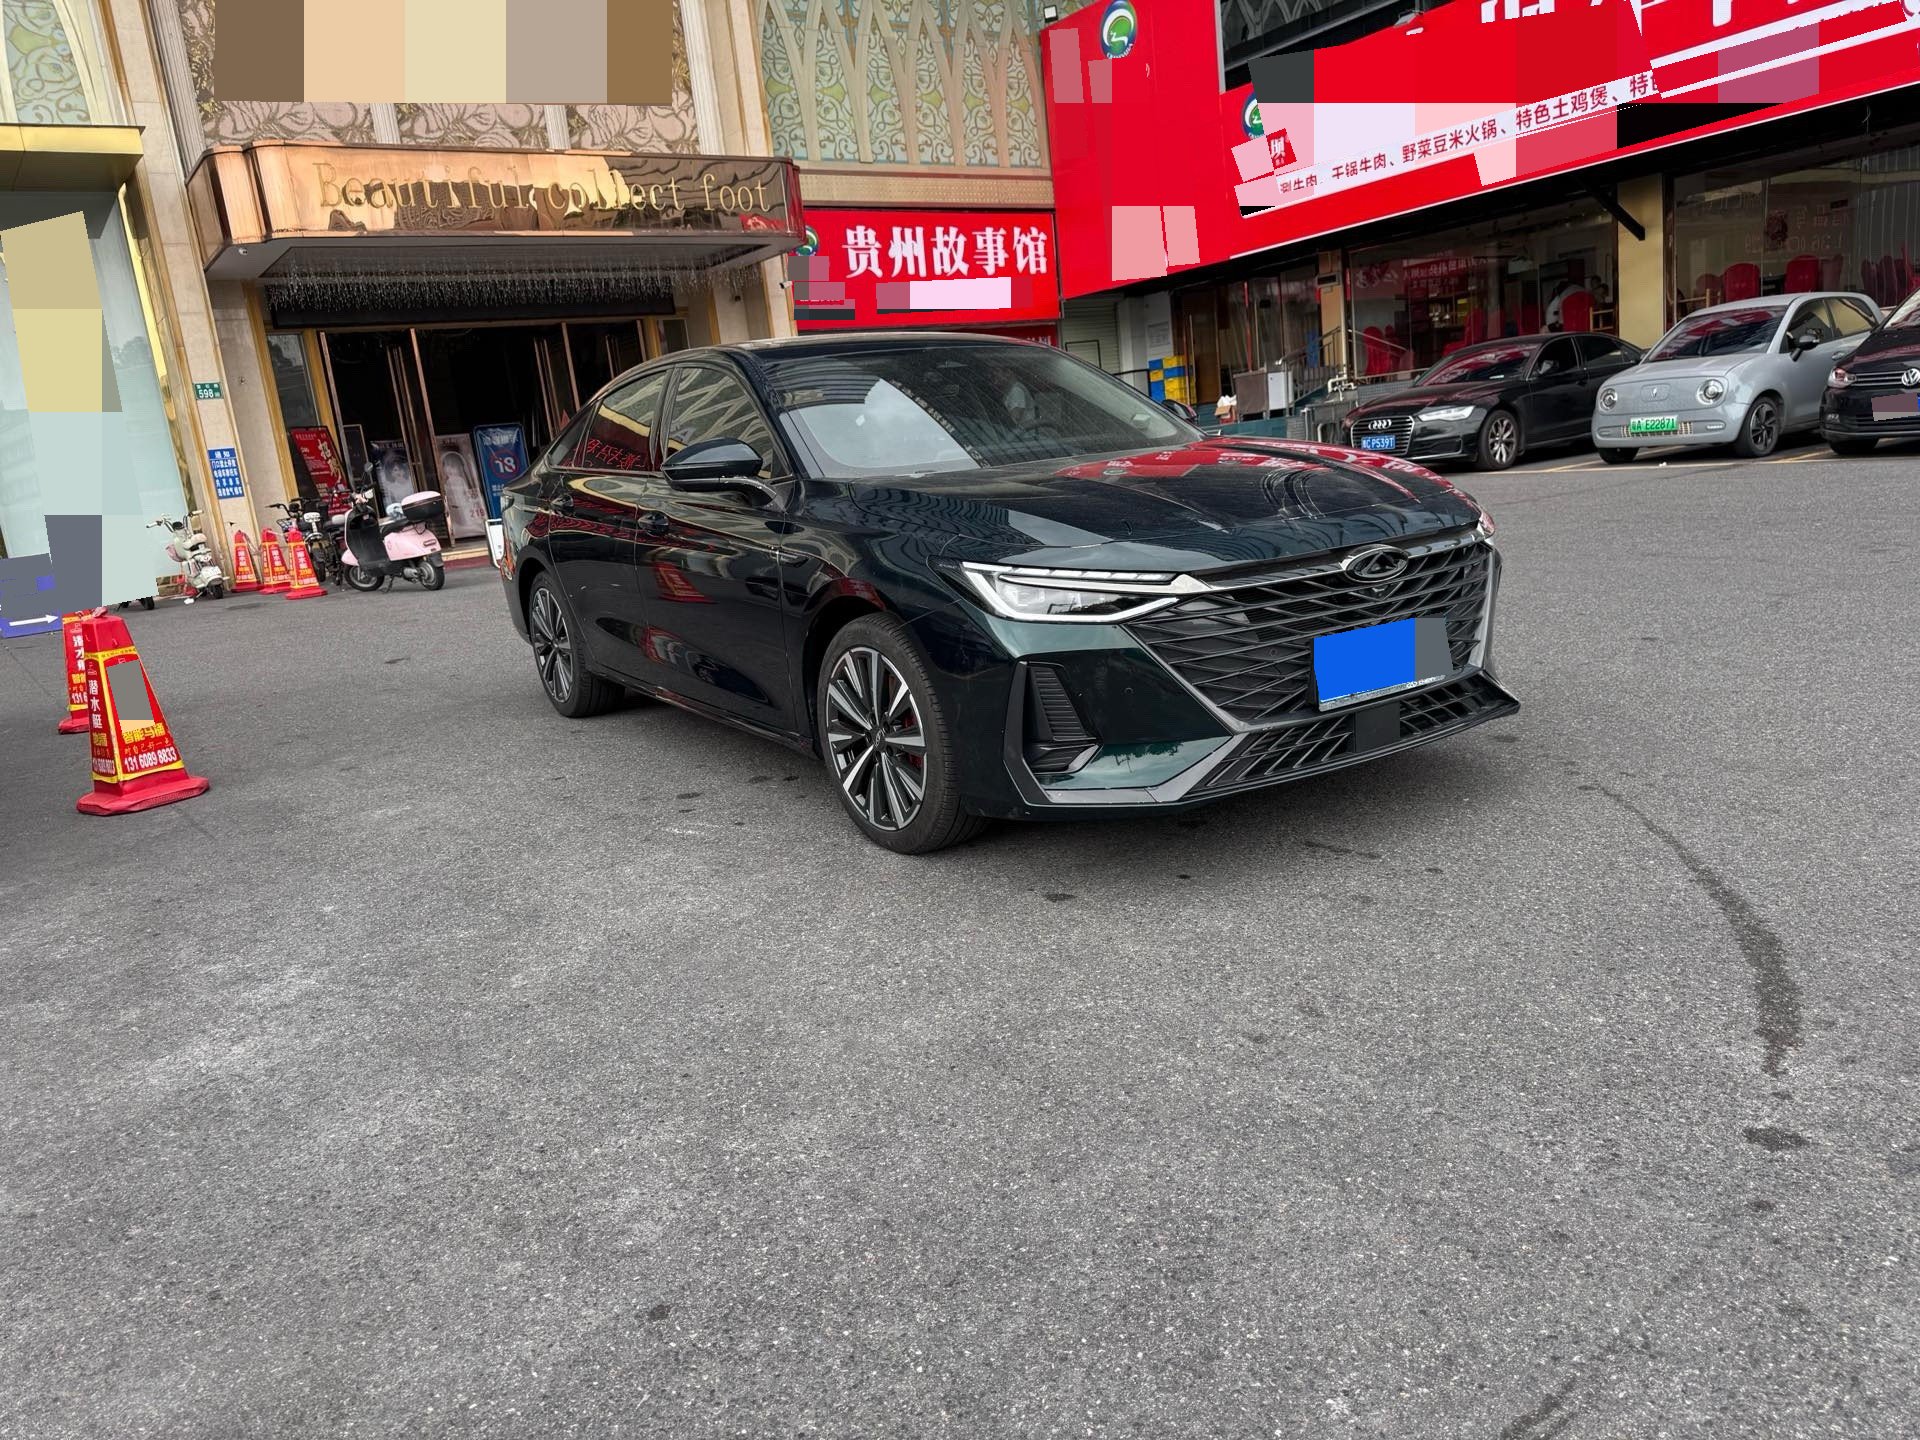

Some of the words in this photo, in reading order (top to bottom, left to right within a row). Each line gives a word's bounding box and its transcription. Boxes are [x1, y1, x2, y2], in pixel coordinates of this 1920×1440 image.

[312, 162, 525, 211] Beautiful
[549, 168, 685, 213] collect
[702, 172, 770, 213] foot
[842, 225, 1048, 278] 贵州故事馆
[88, 679, 103, 729] 潜水艇
[122, 723, 166, 744] 智能马桶
[124, 755, 139, 773] 131
[138, 750, 158, 769] 6089
[157, 746, 178, 765] 8833
